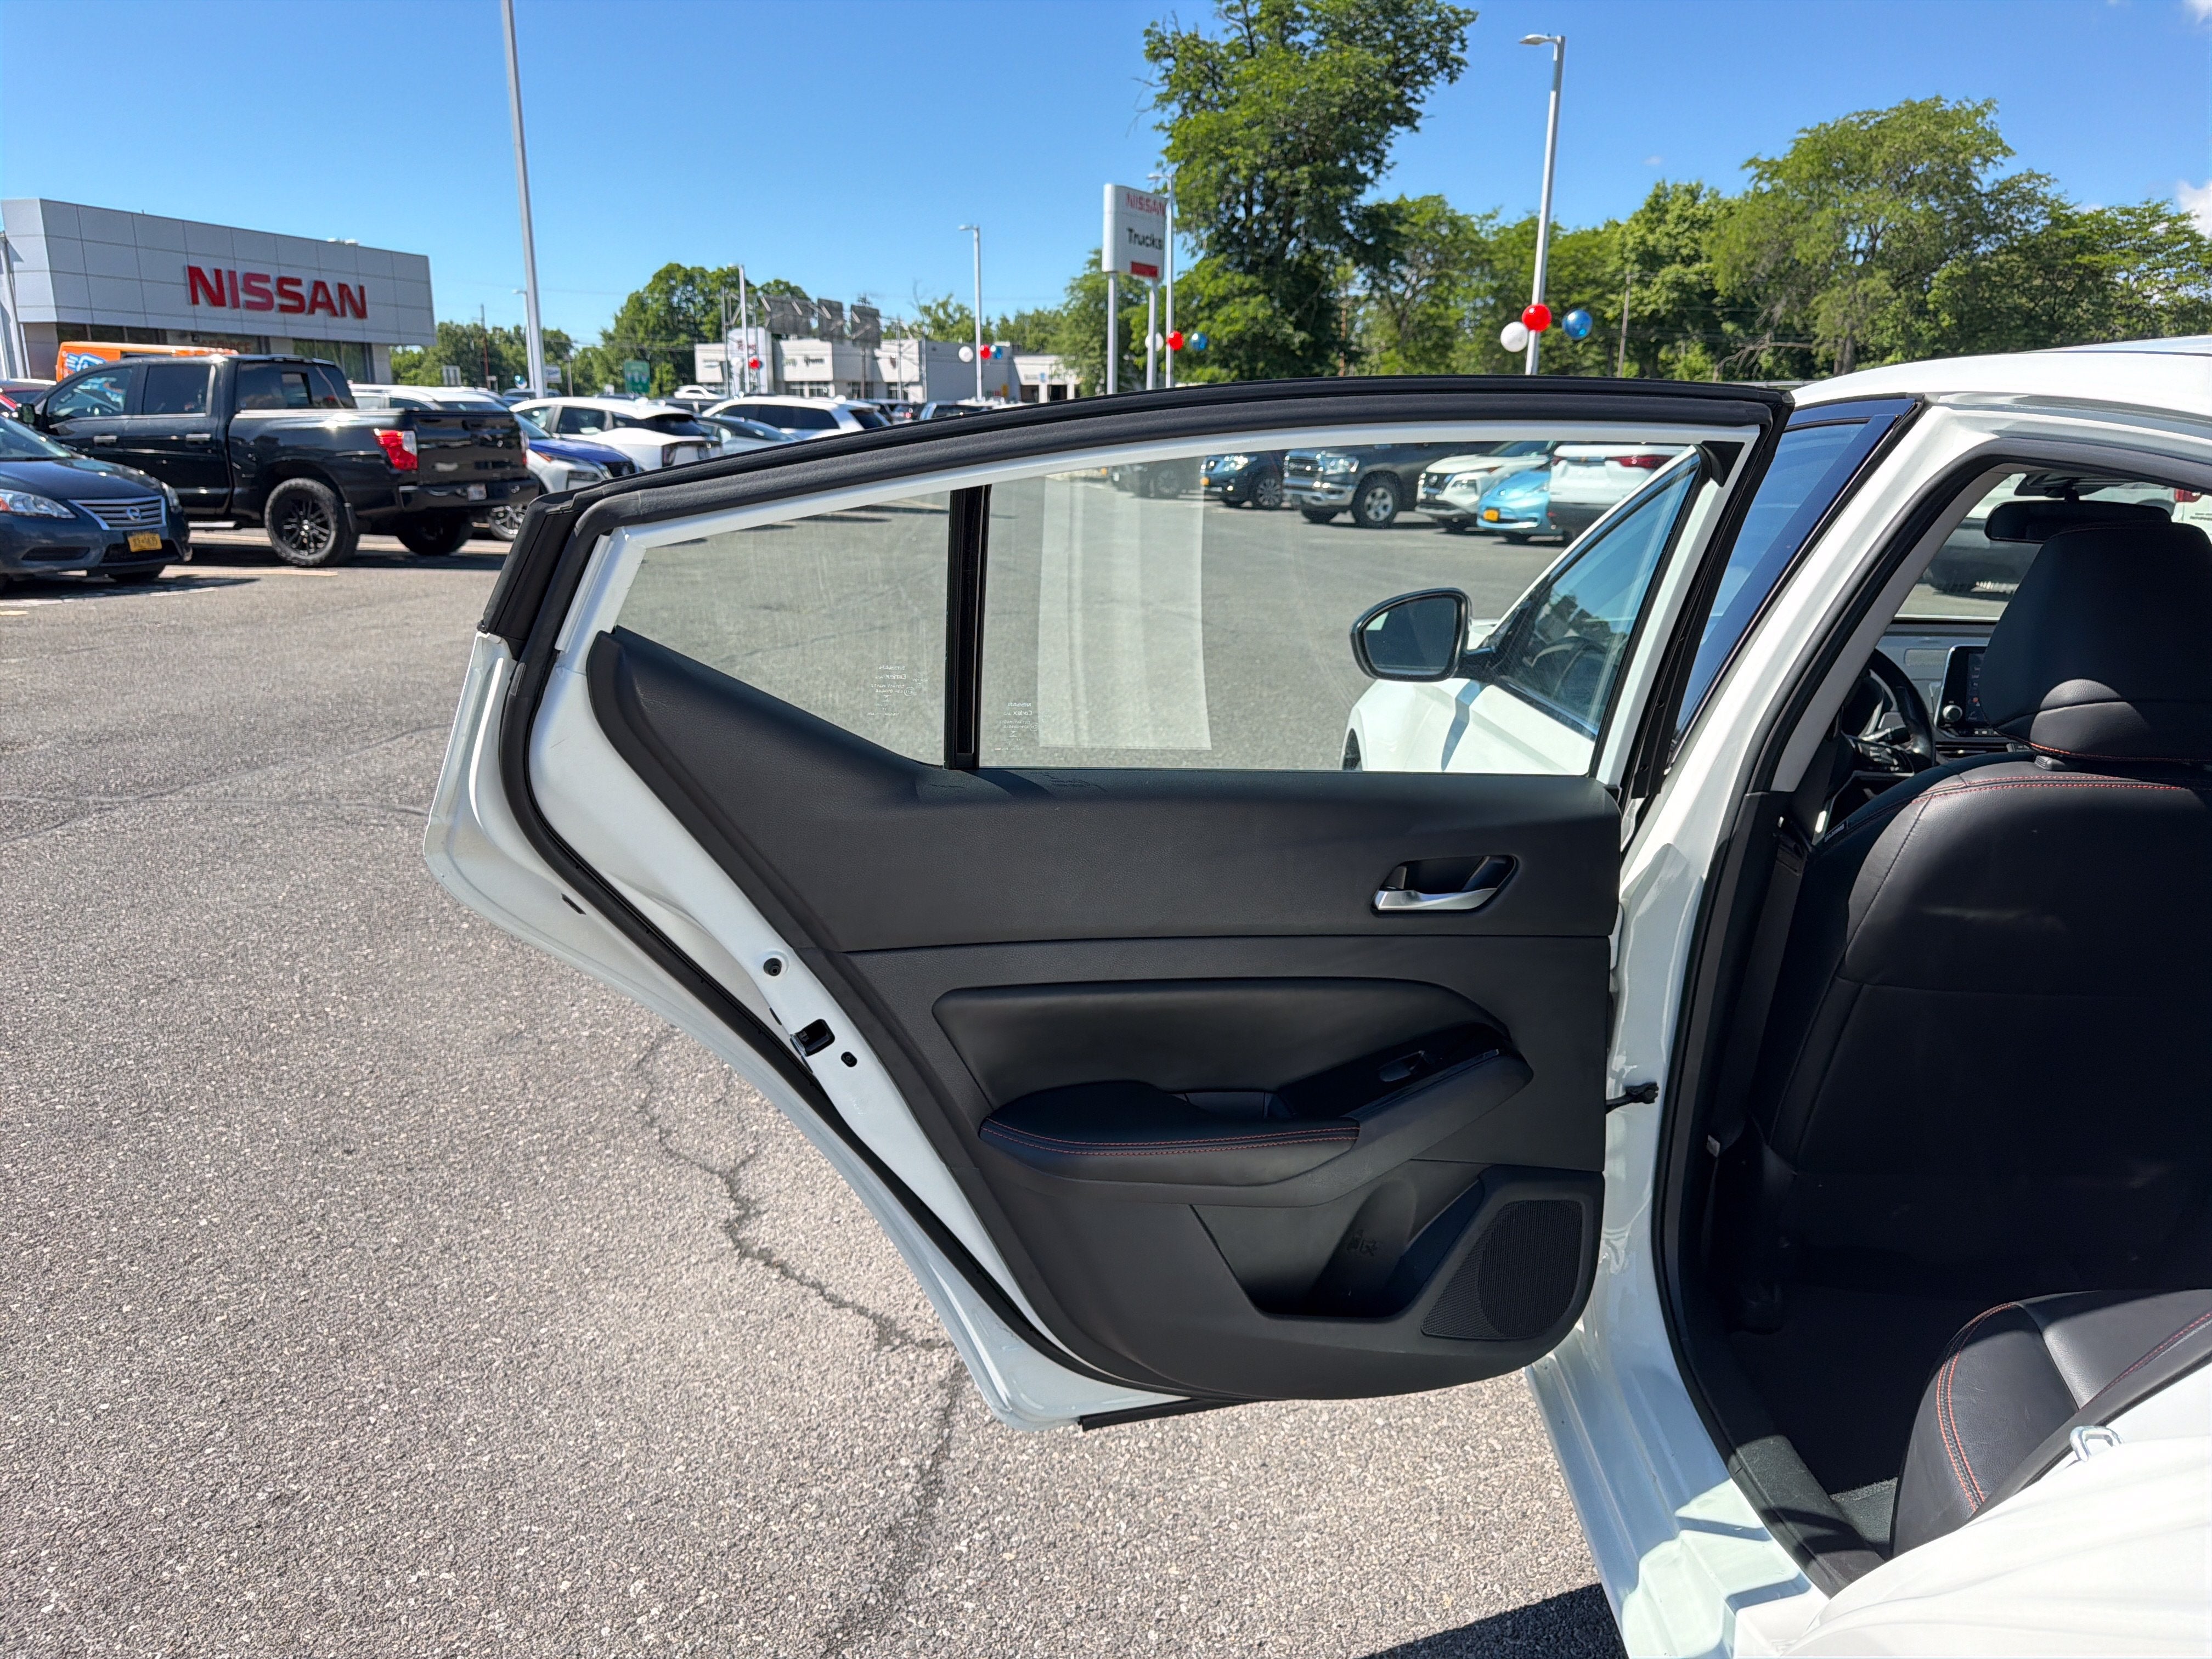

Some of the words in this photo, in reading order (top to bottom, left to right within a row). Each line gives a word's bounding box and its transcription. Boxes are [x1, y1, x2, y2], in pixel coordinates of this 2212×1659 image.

[1126, 194, 1165, 216] NISSAN
[1127, 227, 1164, 250] Trucks
[187, 266, 368, 319] NISSAN
